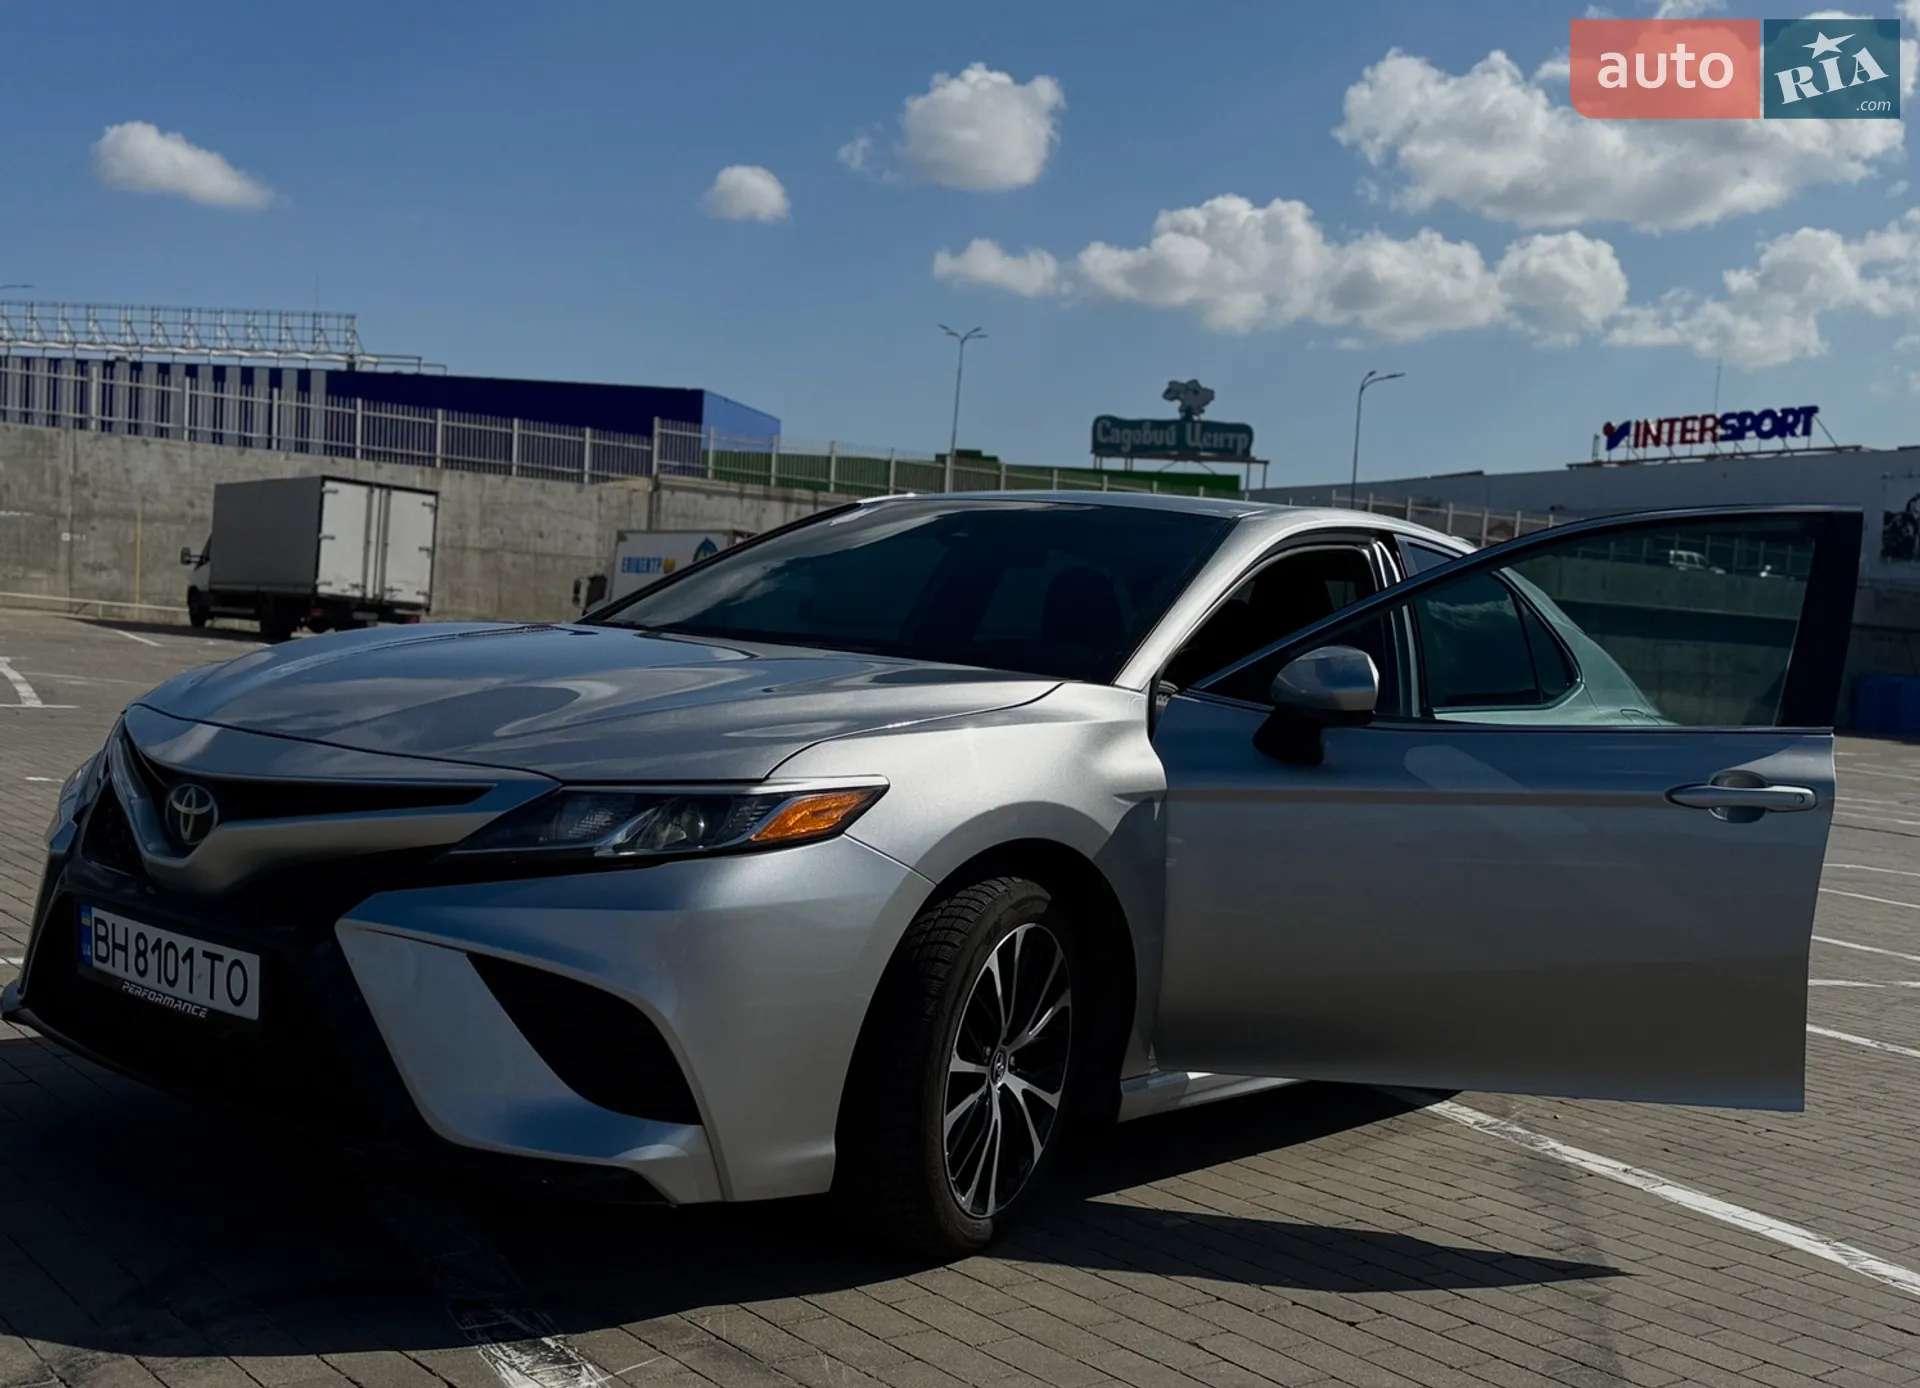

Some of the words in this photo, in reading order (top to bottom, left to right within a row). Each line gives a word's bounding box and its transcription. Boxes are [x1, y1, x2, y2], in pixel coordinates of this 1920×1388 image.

[1096, 418, 1177, 453] Садовий
[1185, 422, 1250, 457] Центр
[1633, 405, 1820, 449] INTERSPORT
[121, 980, 209, 1019] PERFORMANCE
